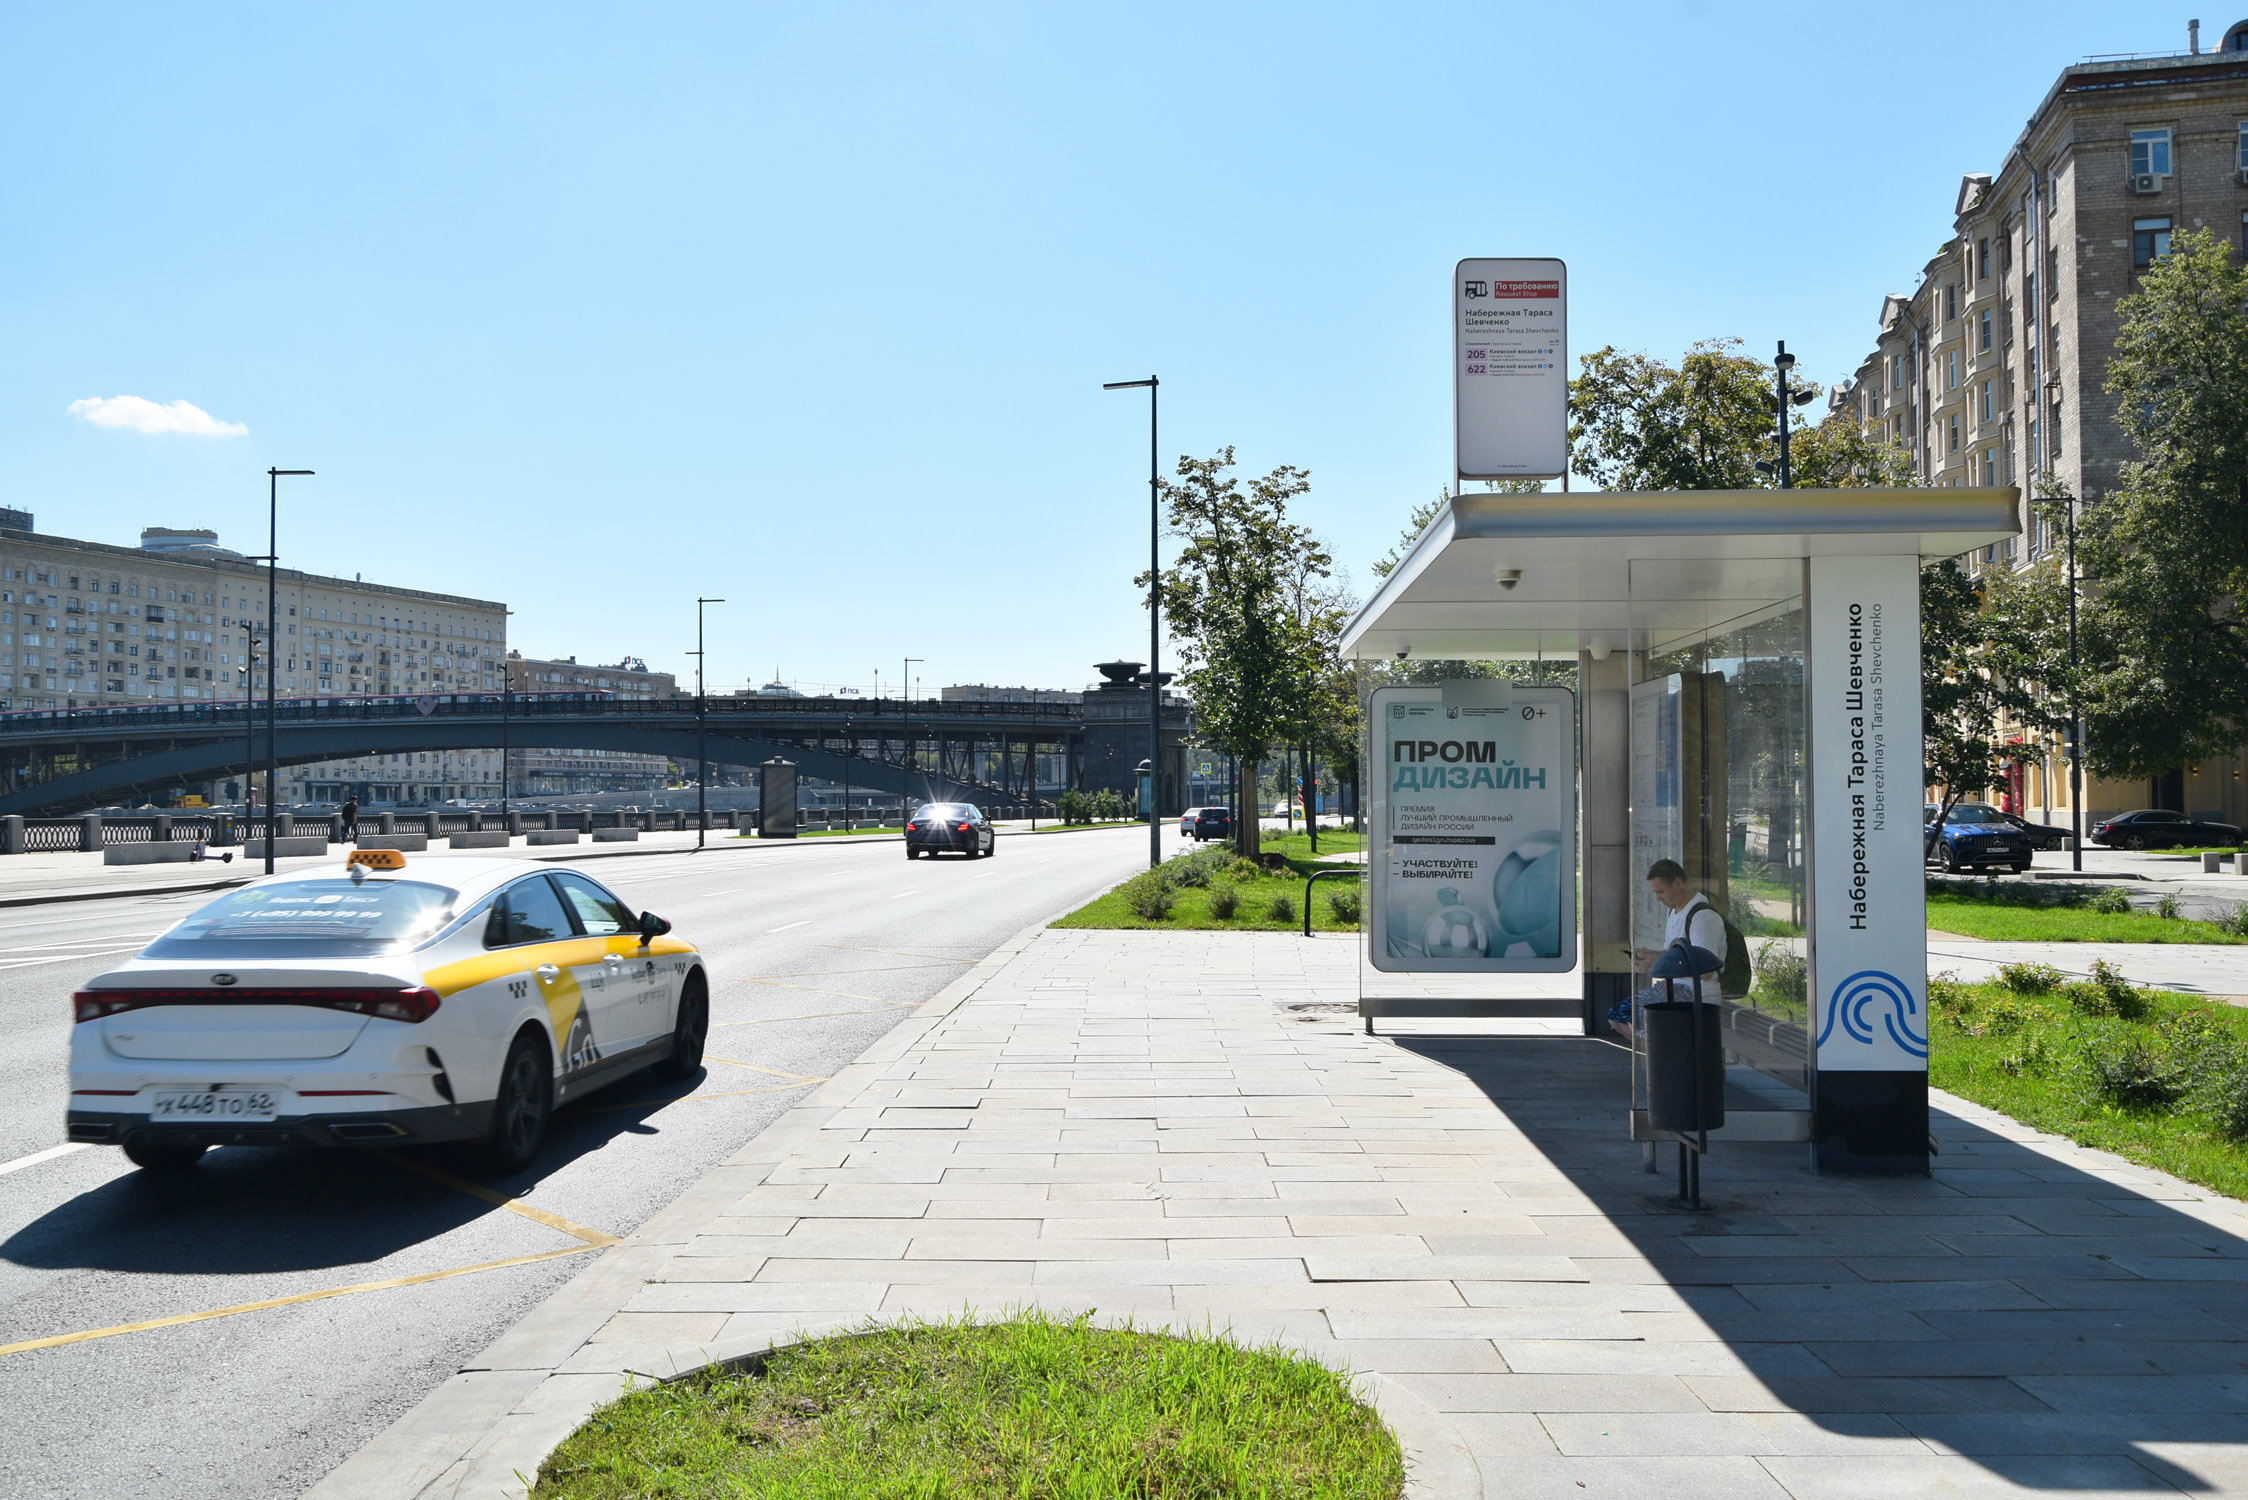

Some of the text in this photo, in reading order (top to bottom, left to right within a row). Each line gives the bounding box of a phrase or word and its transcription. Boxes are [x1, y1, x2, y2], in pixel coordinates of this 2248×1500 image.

[1509, 282, 1558, 291] требованию
[1465, 308, 1553, 318] Набережная Тараса
[1468, 350, 1485, 358] 205
[1468, 365, 1486, 374] 622
[1522, 706, 1546, 720] 0+
[1870, 603, 1888, 831] Naberezhnaya Tarasa Shevchenko
[1394, 740, 1496, 763] ПРОМ
[1846, 603, 1870, 931] Набережная Тараса Шевченко
[1392, 760, 1546, 792] ДИЗАЙН
[1439, 814, 1513, 822] ПРОМЫШЛЕННЫЙ
[1402, 858, 1478, 868] УЧАСТВУЙТЕ!
[1402, 869, 1473, 879] ВЫБИРАЙТЕ!
